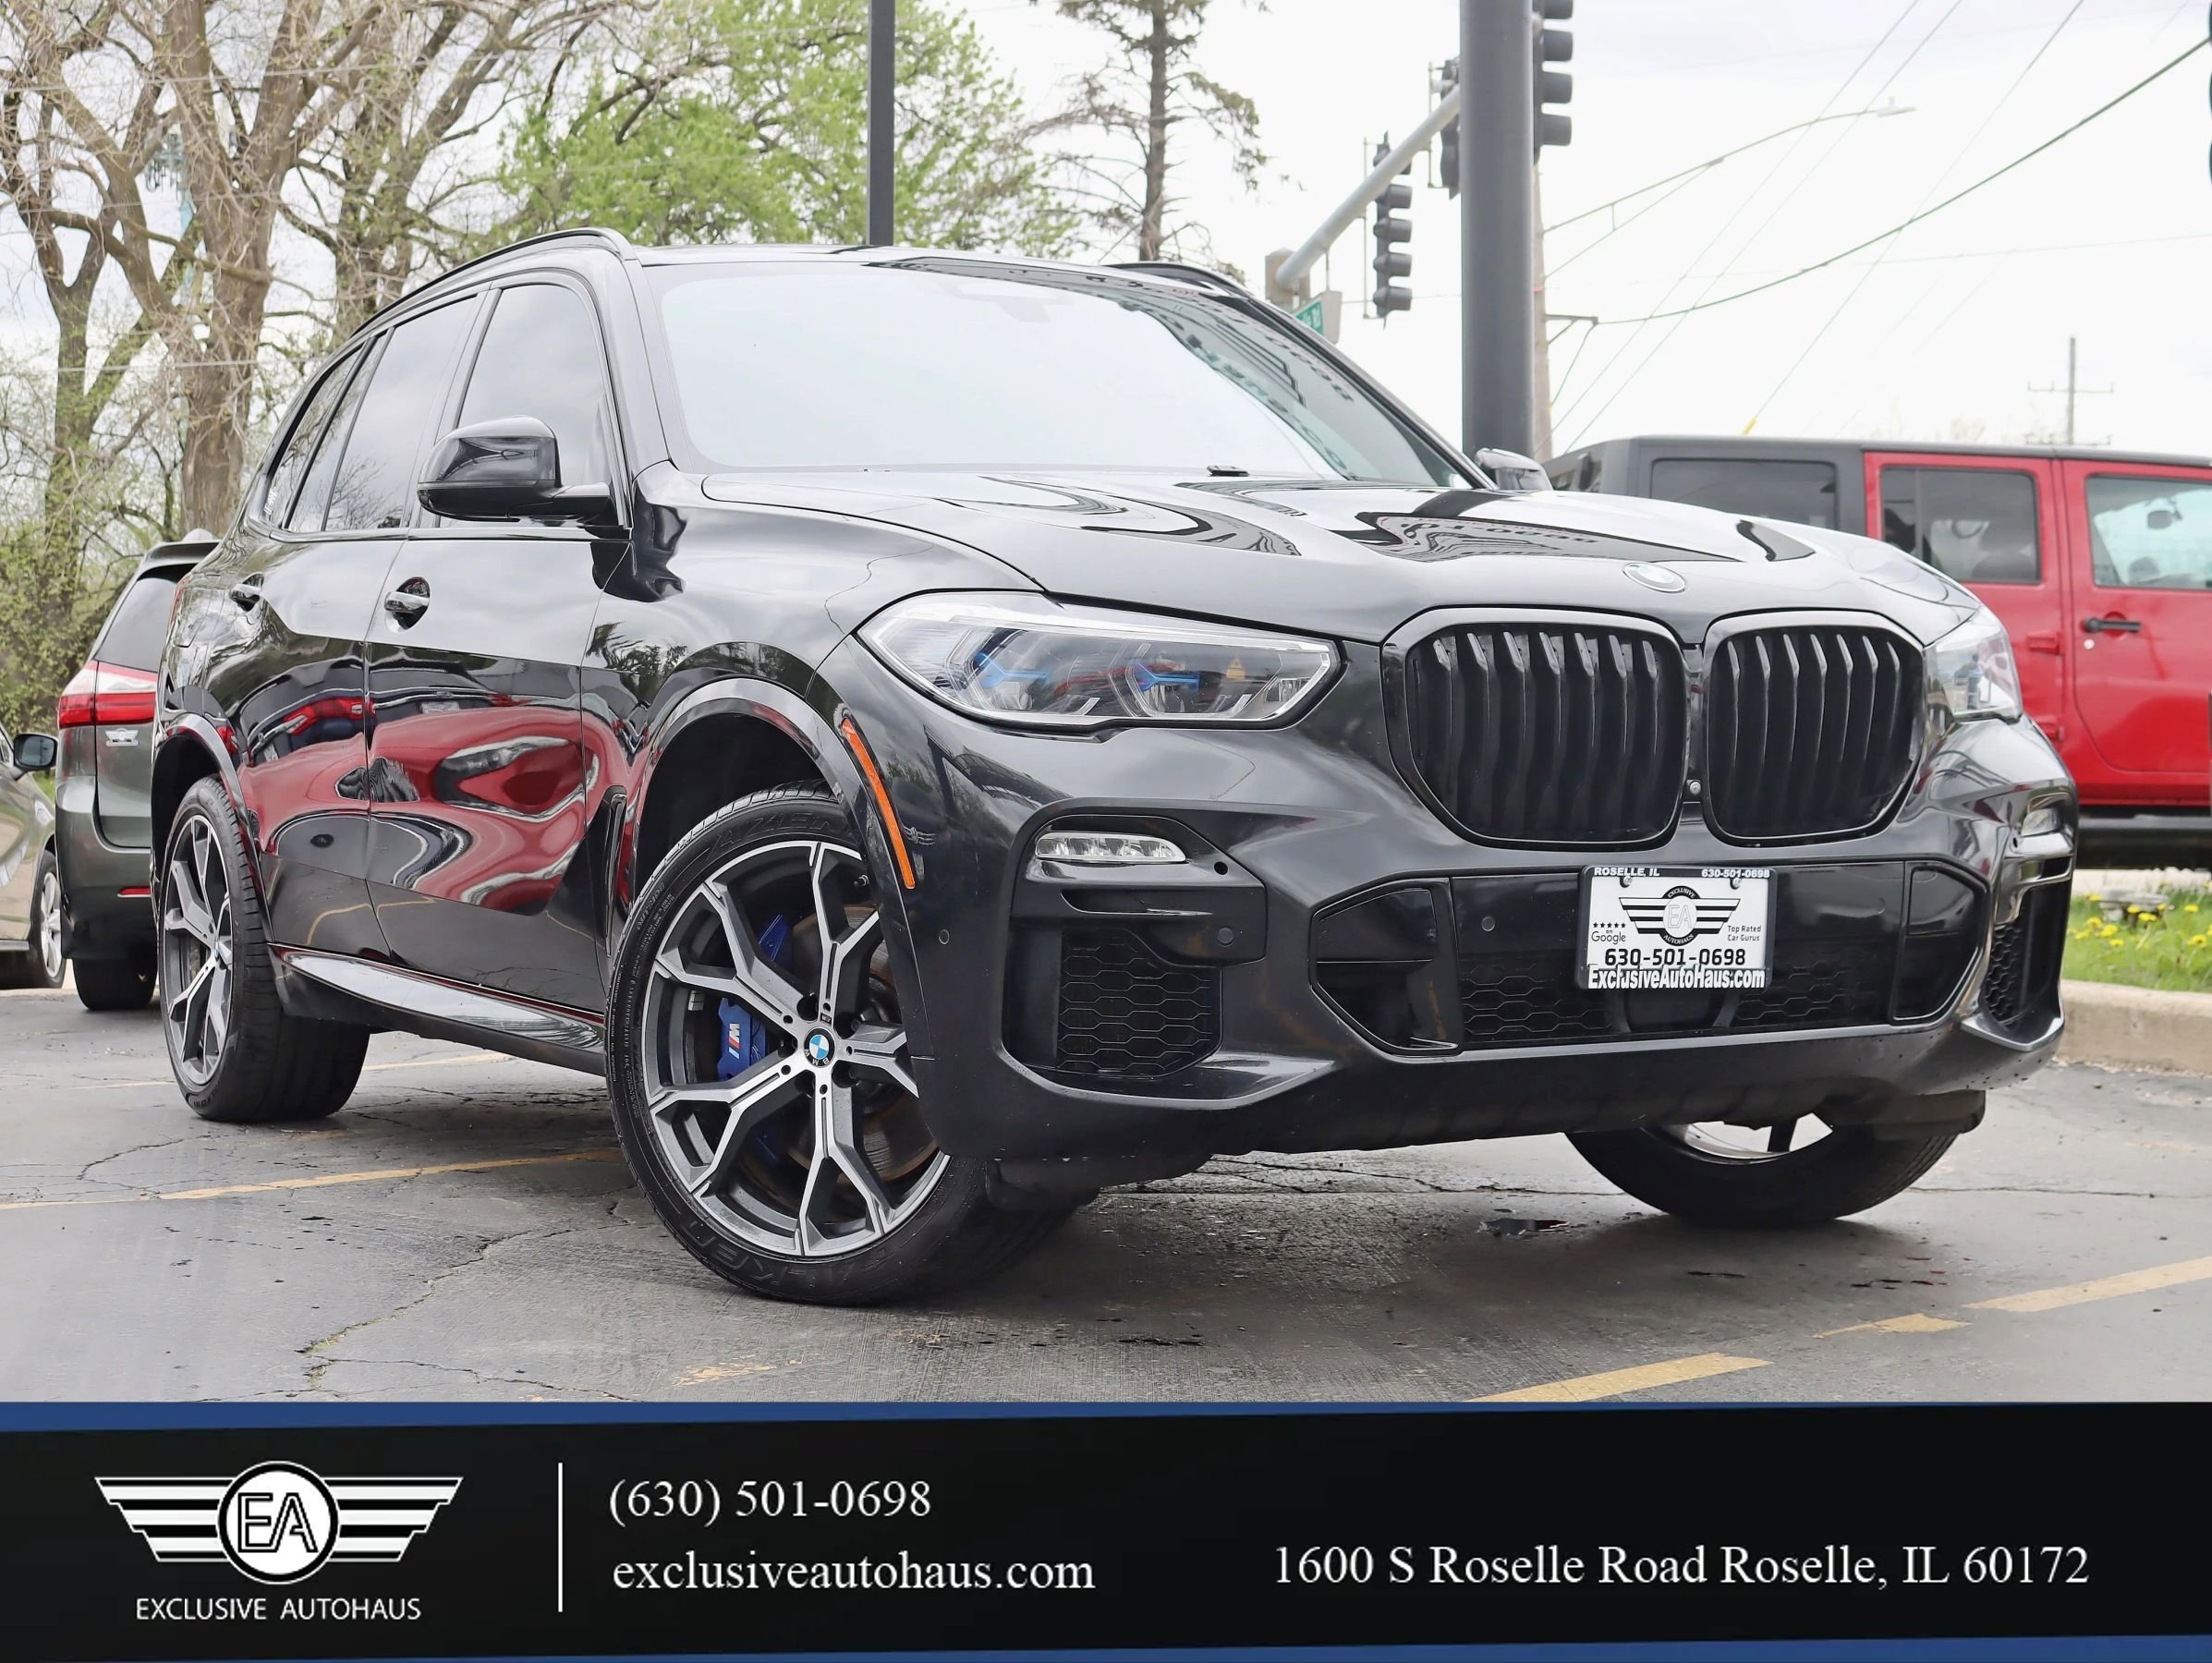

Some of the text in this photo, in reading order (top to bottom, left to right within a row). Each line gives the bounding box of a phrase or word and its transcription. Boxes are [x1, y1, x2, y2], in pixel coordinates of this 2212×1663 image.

[1594, 867, 1660, 878] ROSELLE, IL
[1701, 868, 1770, 879] 630-501-0698
[1667, 904, 1693, 929] EA
[1727, 925, 1762, 934] Top Rated
[1591, 930, 1626, 945] Google
[1663, 933, 1695, 945] AUTOHAUS
[1604, 948, 1746, 967] 630-501-0698
[1587, 964, 1767, 989] ExclusiveAutoHaus.com
